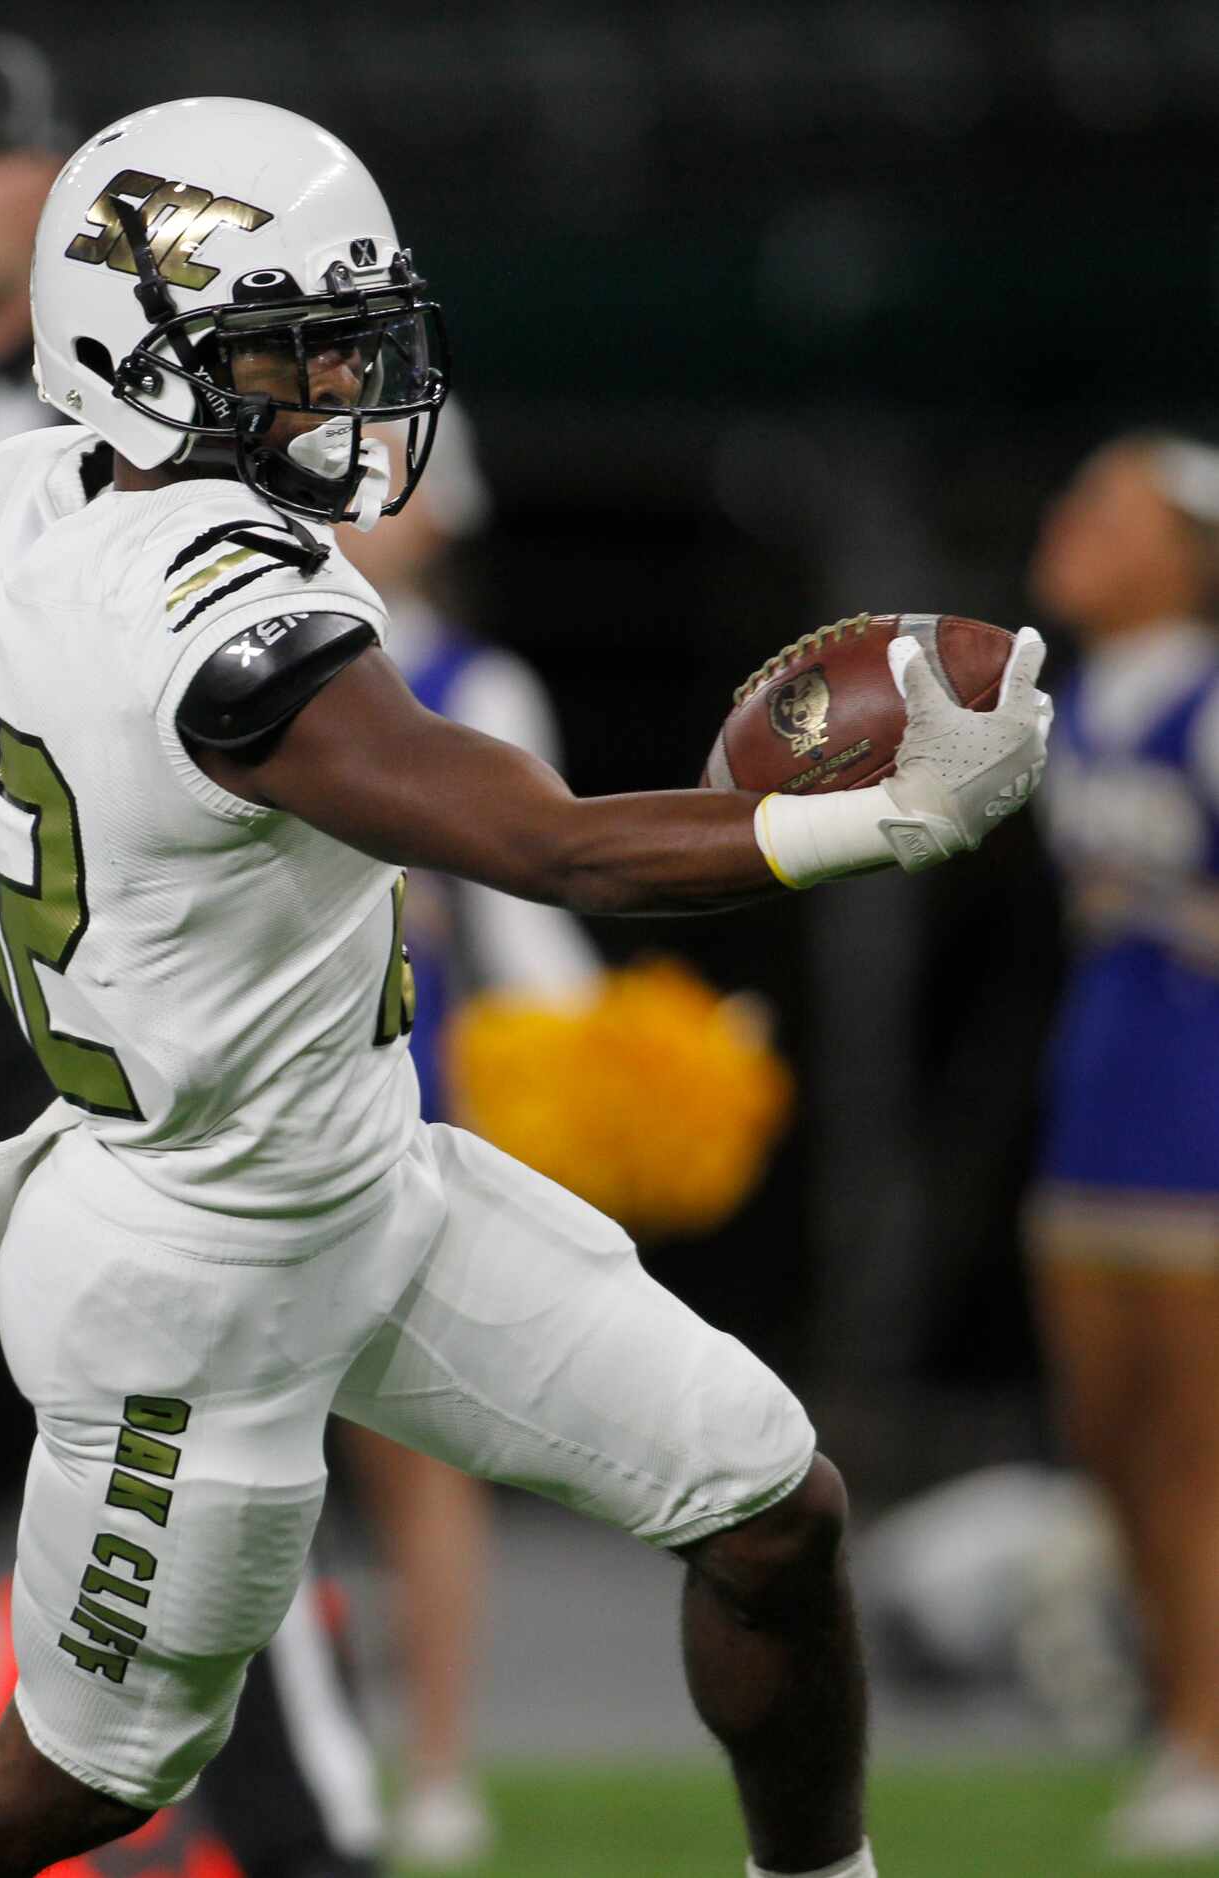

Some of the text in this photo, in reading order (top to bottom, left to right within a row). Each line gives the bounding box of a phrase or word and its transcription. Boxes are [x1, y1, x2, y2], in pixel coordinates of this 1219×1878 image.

[825, 738, 871, 771] ISSUE
[58, 1394, 192, 1684] OAK CLIFF
